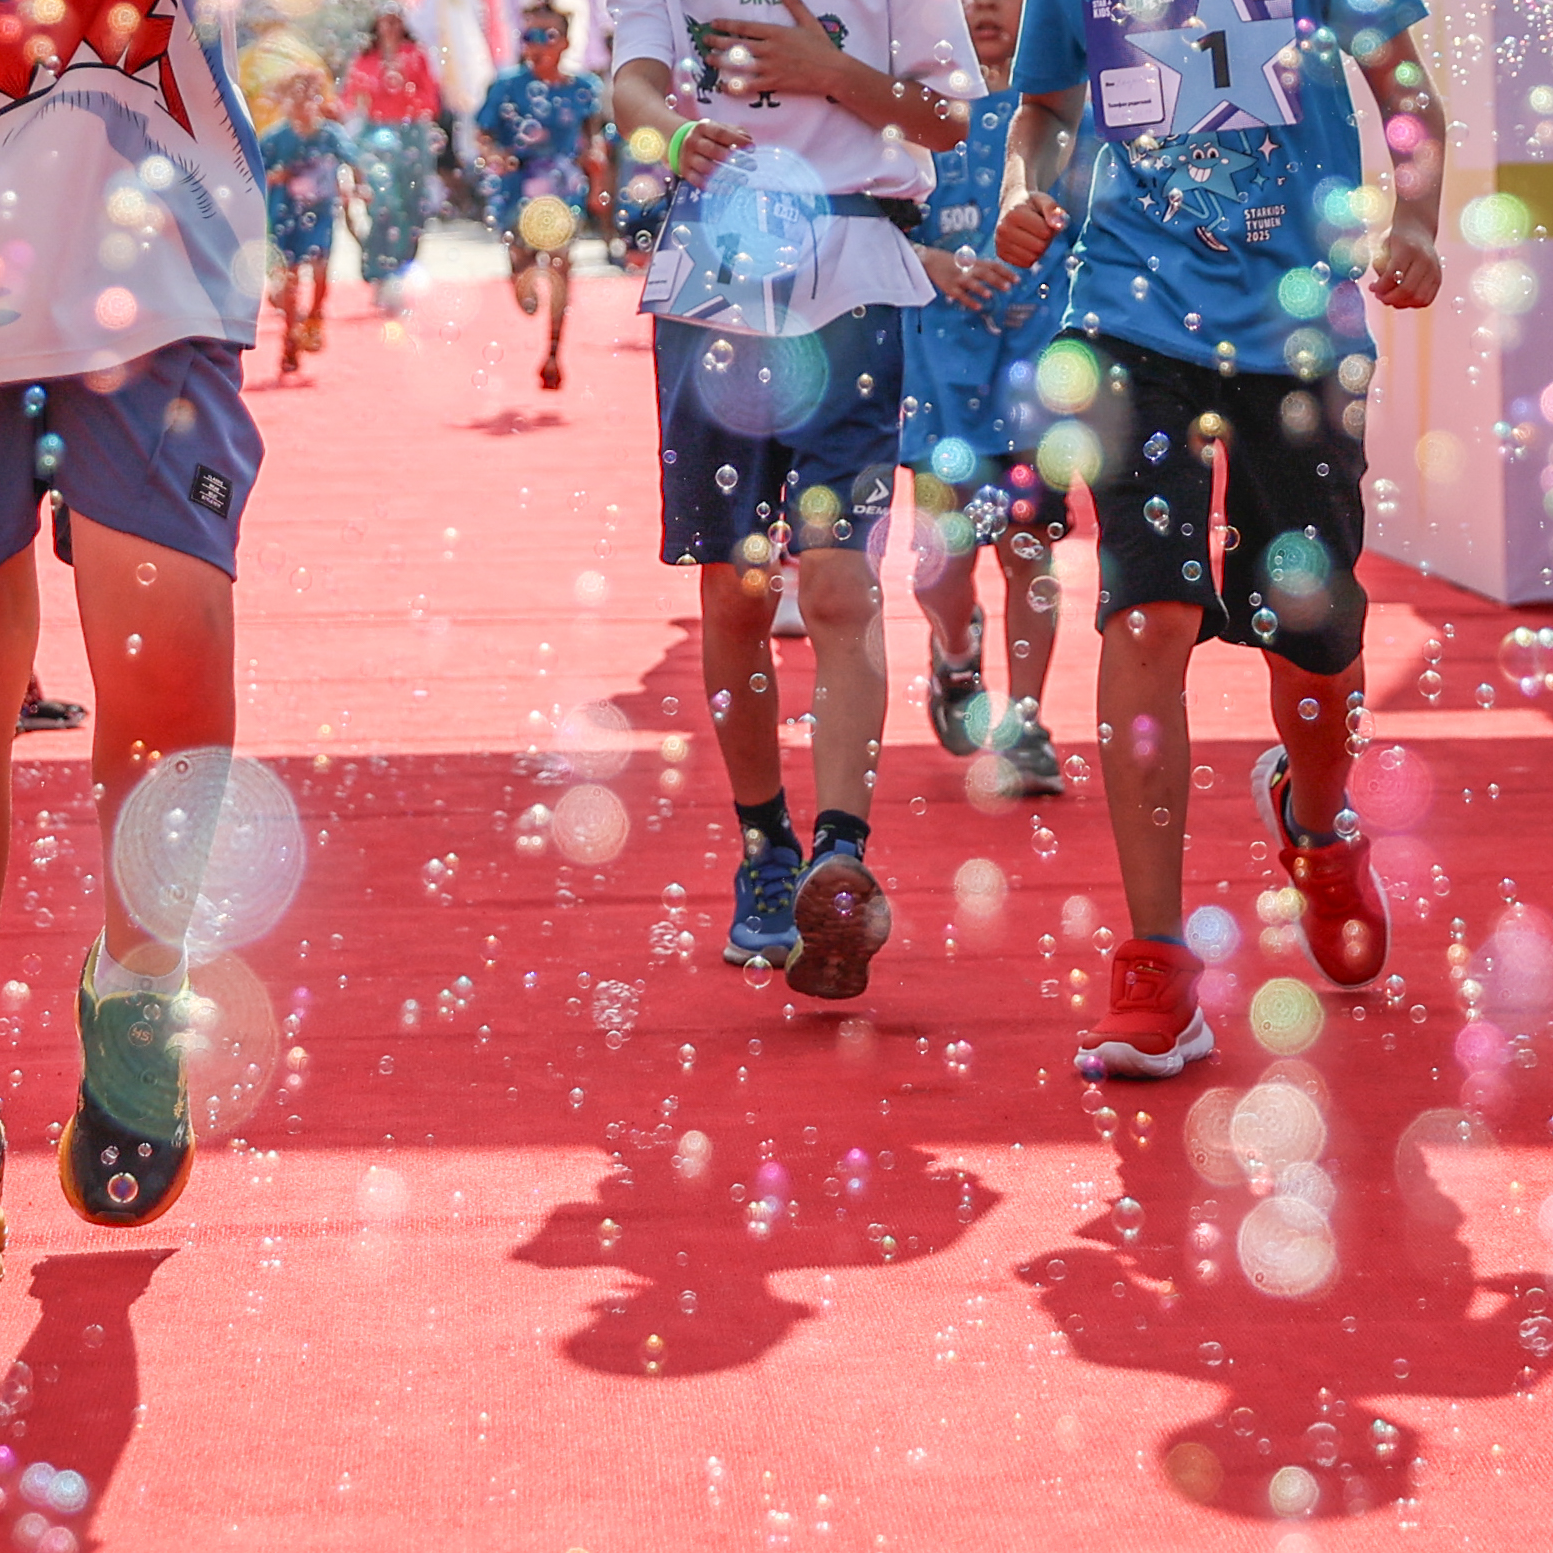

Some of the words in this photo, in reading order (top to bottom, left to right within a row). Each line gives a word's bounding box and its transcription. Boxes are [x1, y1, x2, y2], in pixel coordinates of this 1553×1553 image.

[1092, 0, 1108, 9] STAR
[1093, 7, 1111, 18] KIDS
[1196, 30, 1231, 89] 1
[1244, 204, 1286, 220] STARKIDS
[1246, 217, 1282, 231] TYUMEN
[1246, 231, 1271, 243] 2025
